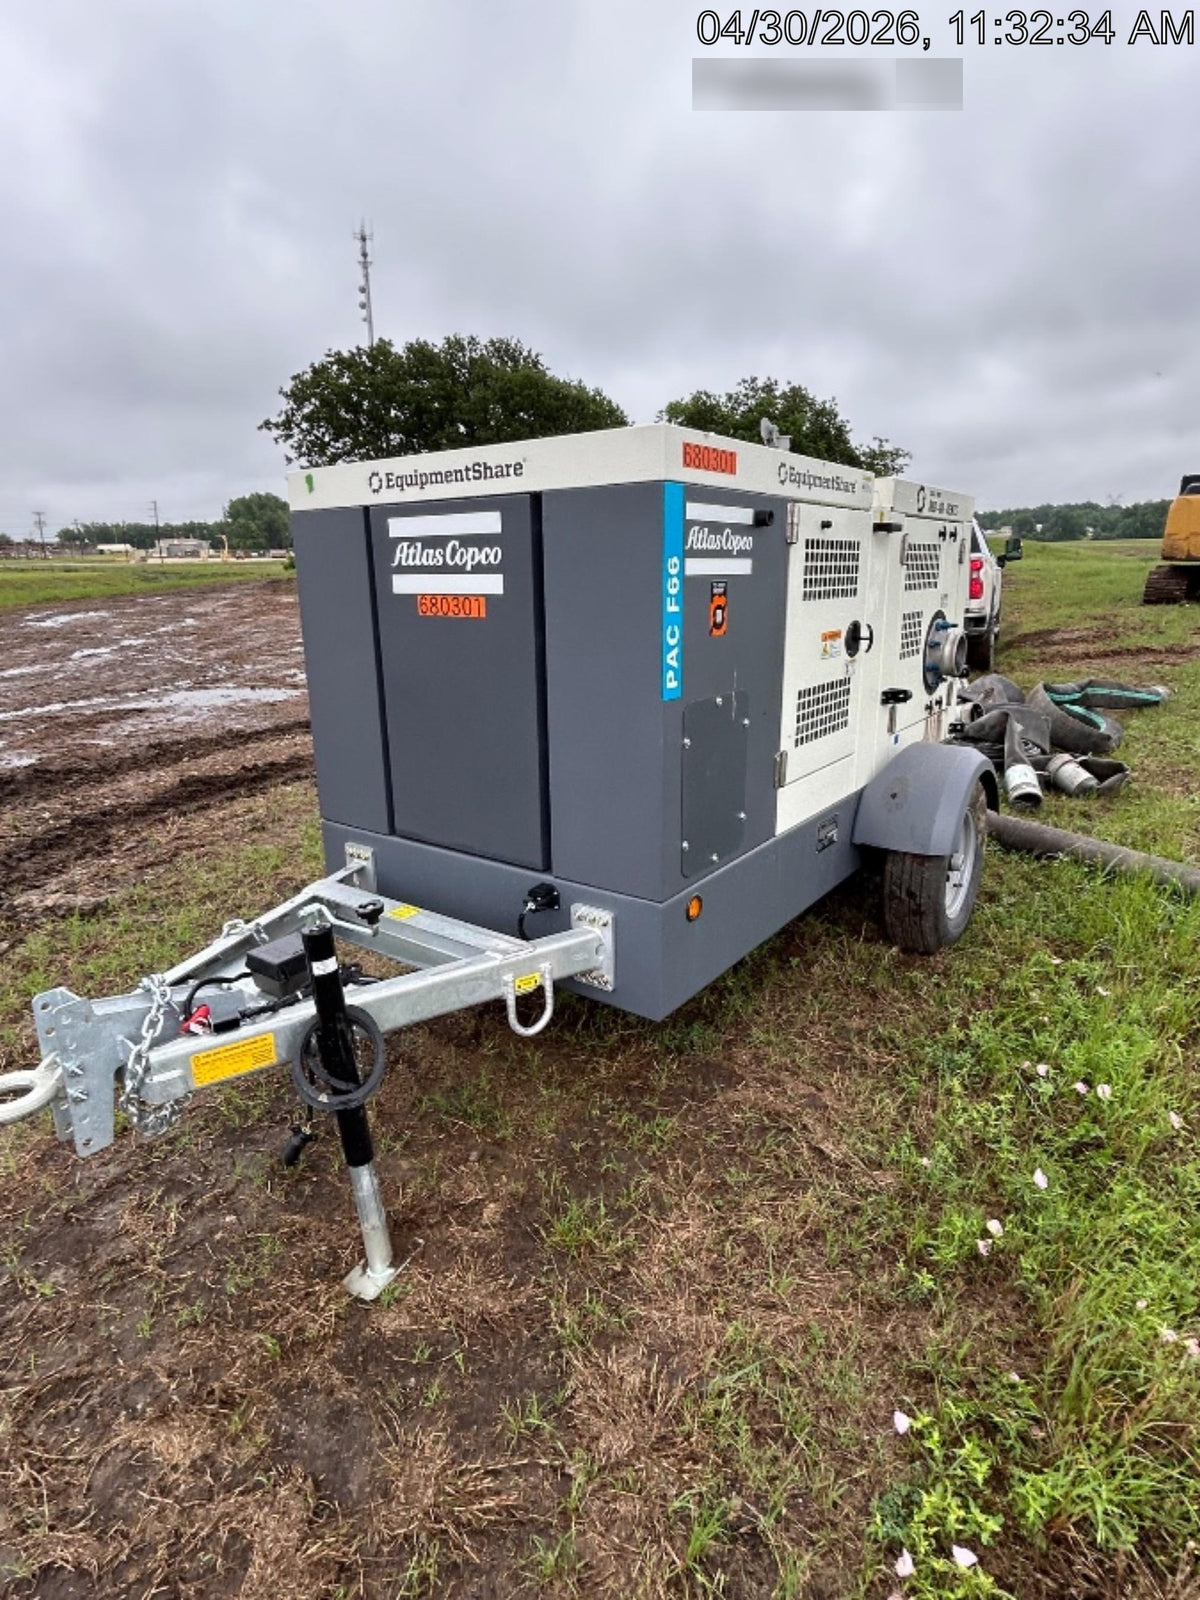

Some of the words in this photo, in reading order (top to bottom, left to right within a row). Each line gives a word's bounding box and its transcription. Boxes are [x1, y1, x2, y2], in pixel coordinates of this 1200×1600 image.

[684, 443, 736, 474] 680301
[385, 461, 524, 491] EquipmentShare
[788, 466, 856, 494] EquipmentShare
[391, 541, 444, 567] Atlas
[445, 540, 502, 571] Copco
[685, 525, 722, 550] Atlas
[721, 527, 753, 556] Copco
[666, 556, 680, 613] F66
[419, 595, 482, 617] 680301
[666, 624, 680, 689] PAC
